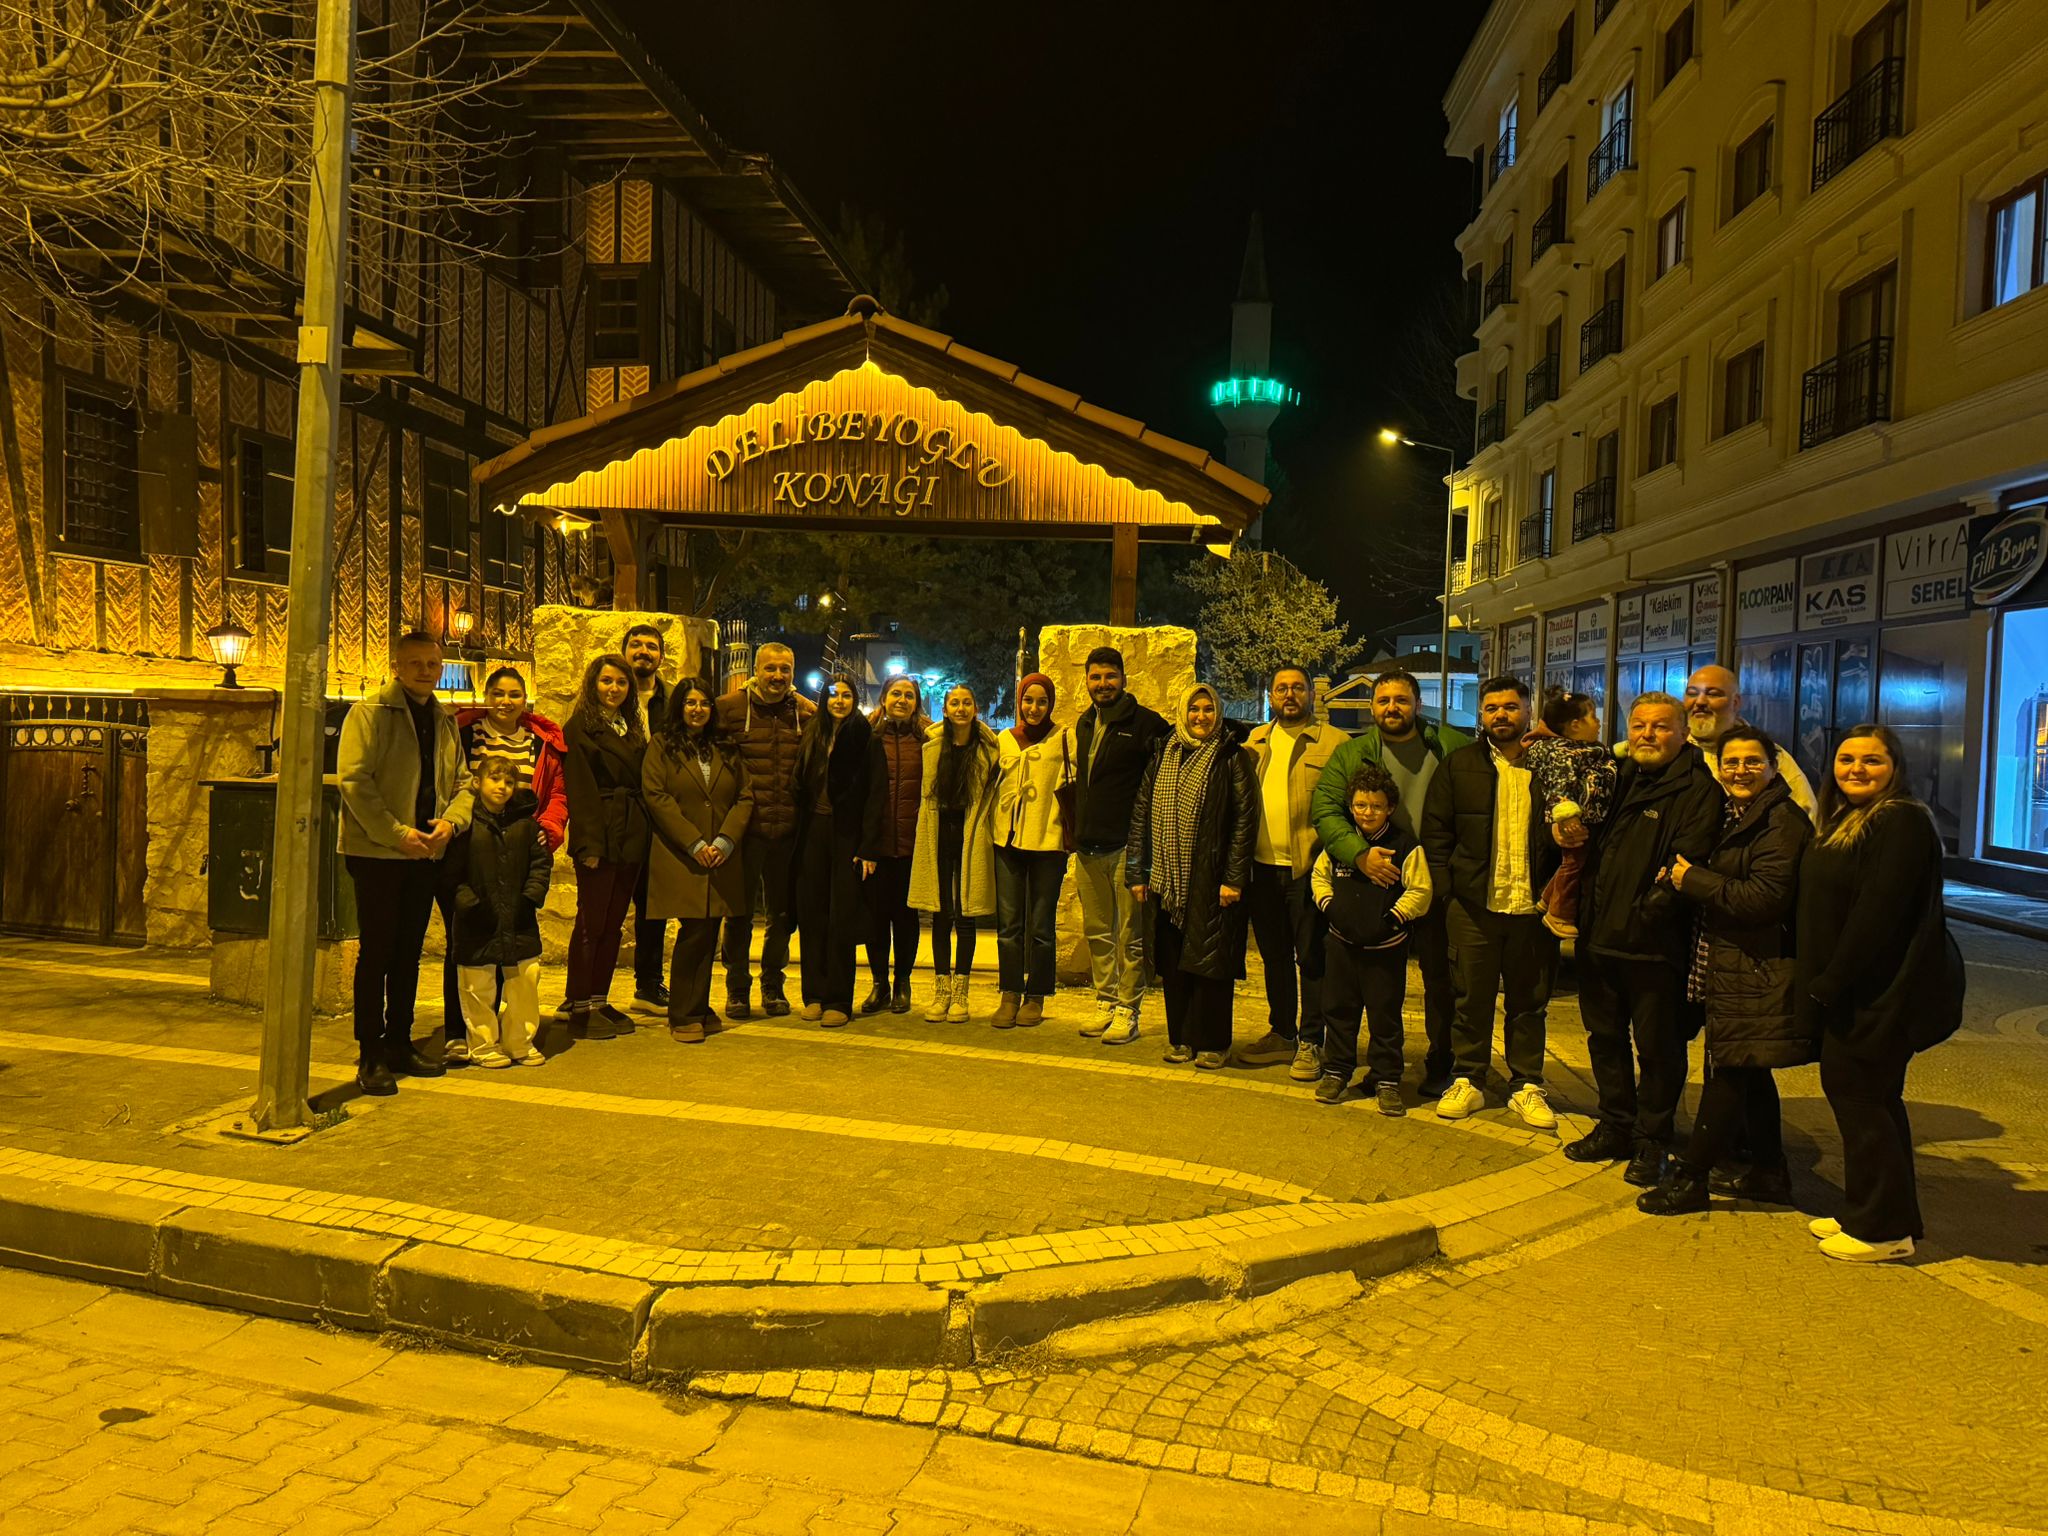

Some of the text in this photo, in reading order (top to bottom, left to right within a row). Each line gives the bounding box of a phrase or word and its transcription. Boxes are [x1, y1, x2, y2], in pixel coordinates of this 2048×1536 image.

[773, 465, 940, 516] KONAĞI
[1896, 523, 1969, 571] VitrA
[1970, 535, 2038, 582] Filli Boya
[1652, 593, 1682, 614] Kalekim
[1738, 582, 1794, 610] FLOORPAN
[1805, 584, 1866, 613] KAS
[1911, 577, 1967, 605] SEREL
[1555, 636, 1573, 648] BOSCH
